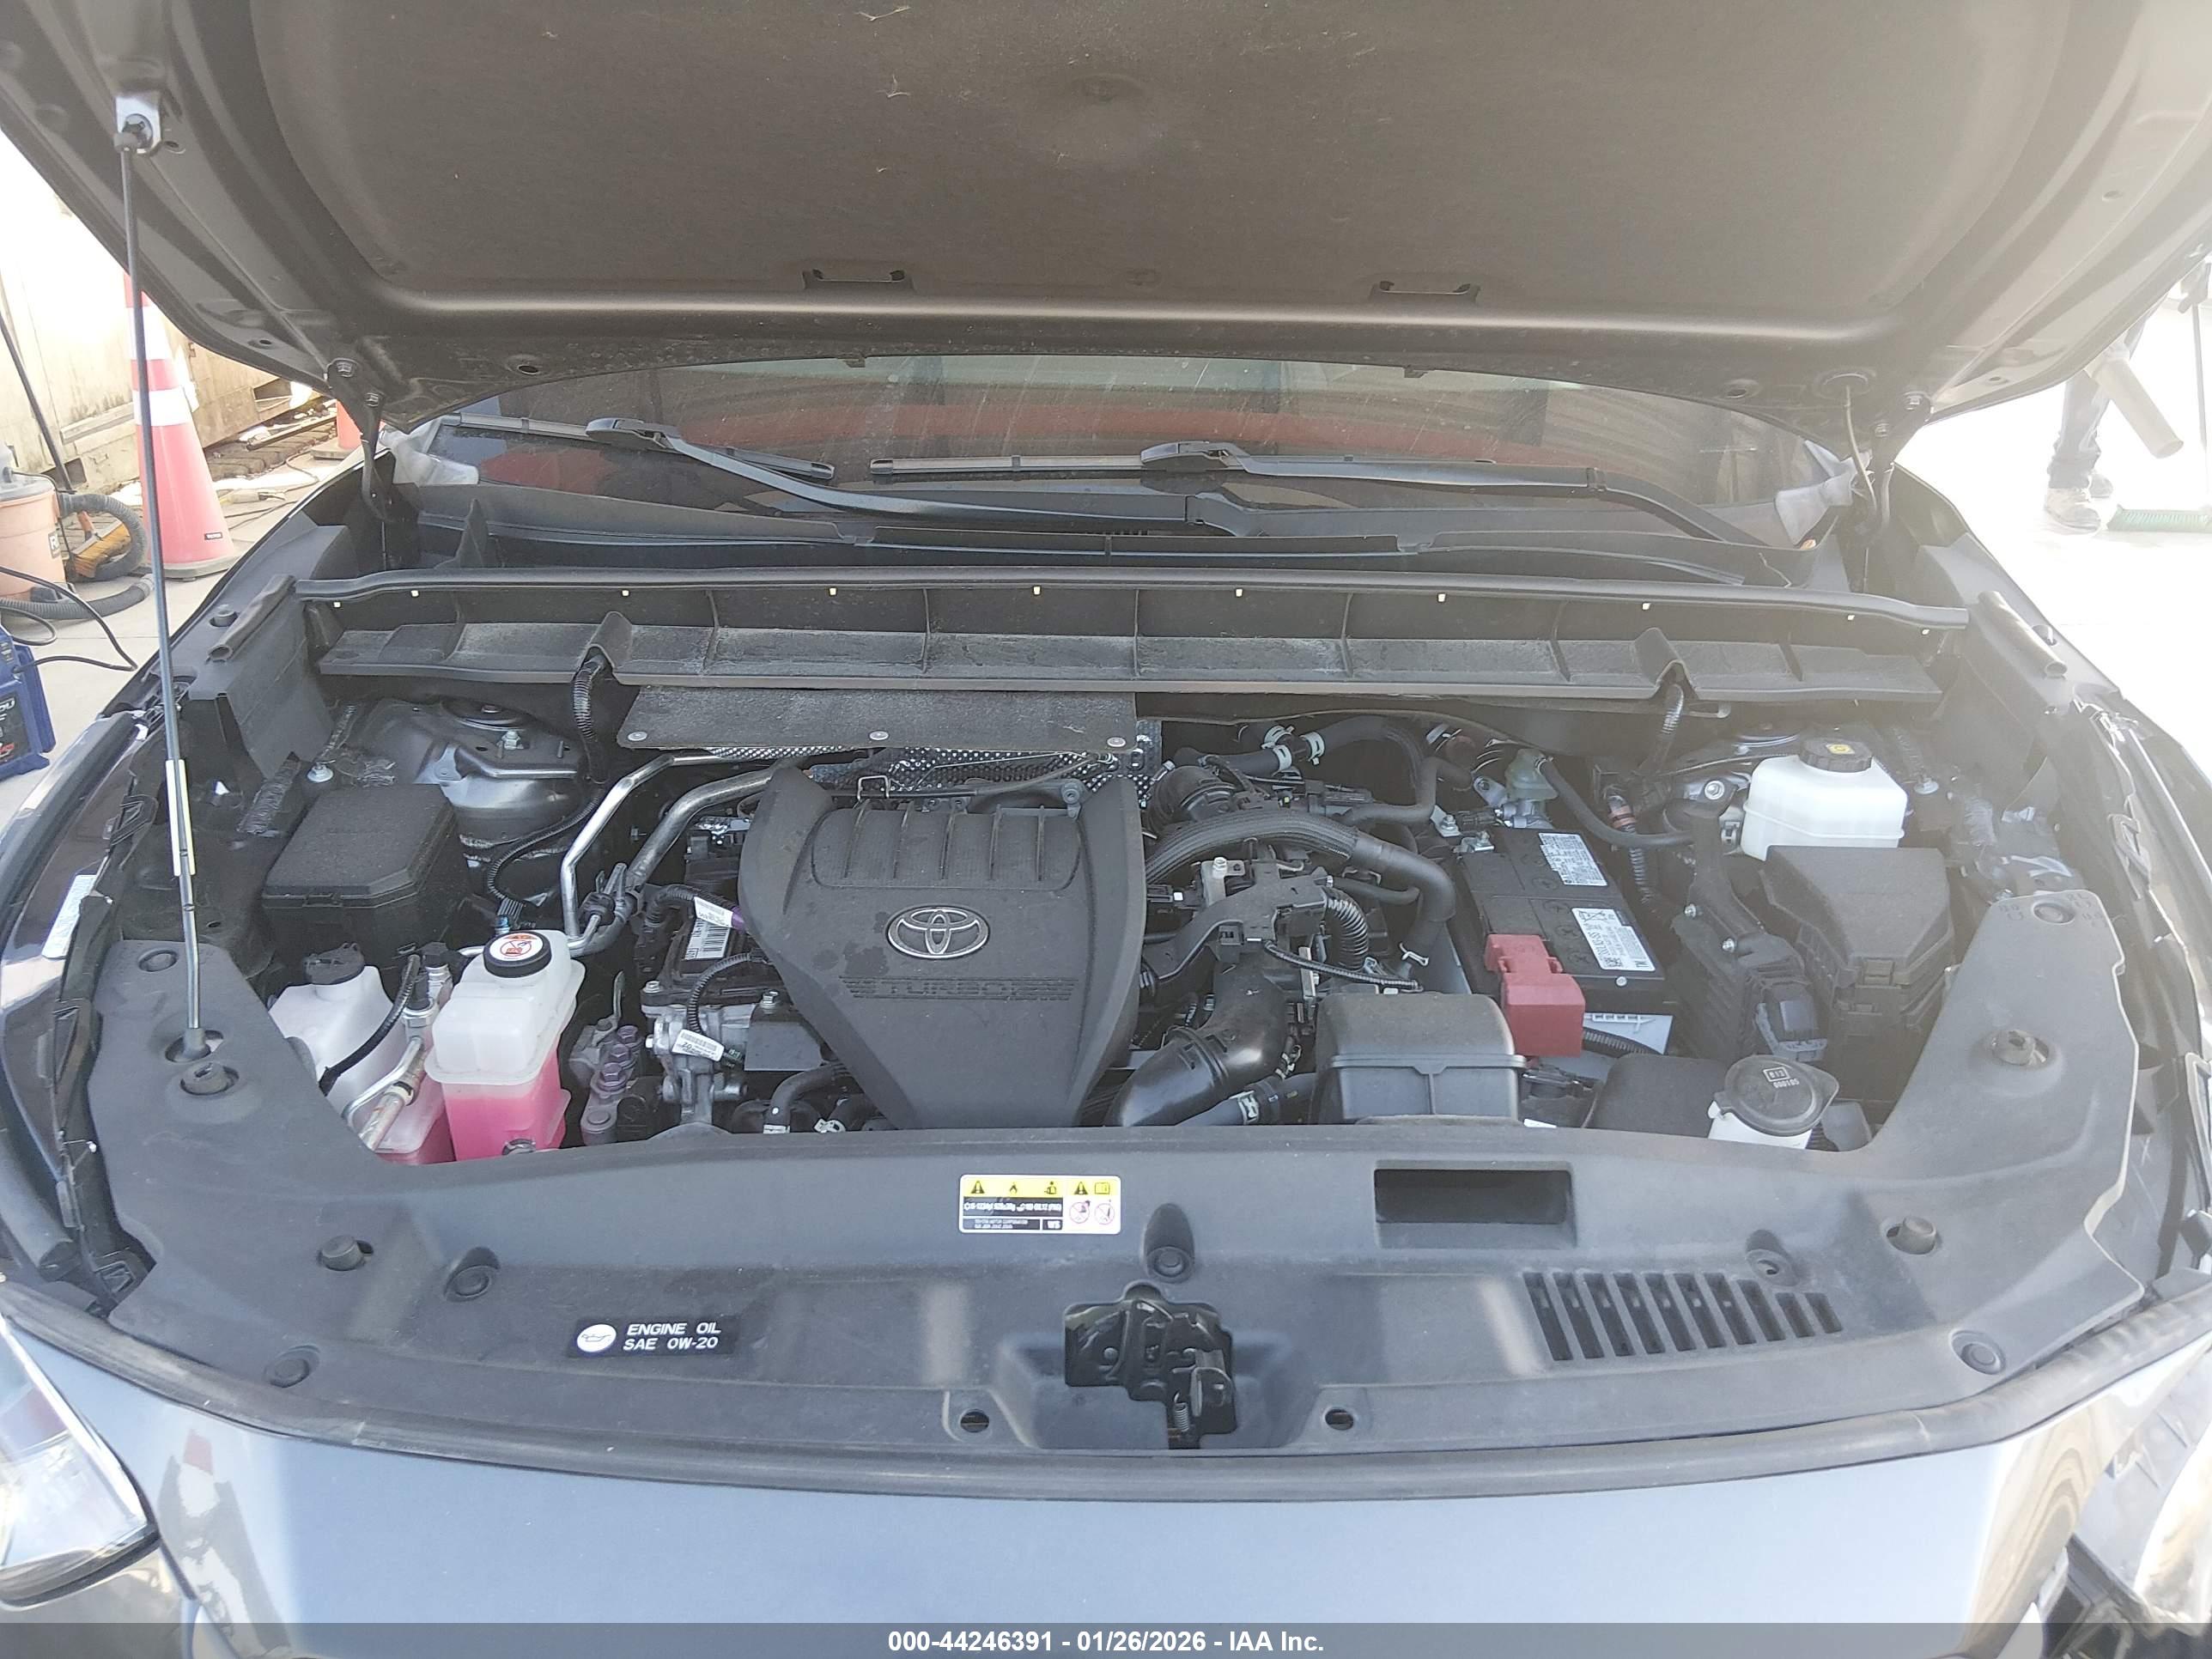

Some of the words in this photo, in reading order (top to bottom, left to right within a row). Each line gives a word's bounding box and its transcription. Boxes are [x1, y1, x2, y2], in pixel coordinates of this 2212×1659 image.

[626, 1322, 688, 1335] ENGINE
[696, 1322, 721, 1334] OIL
[623, 1337, 659, 1351] SAE
[666, 1336, 719, 1350] 0W-20
